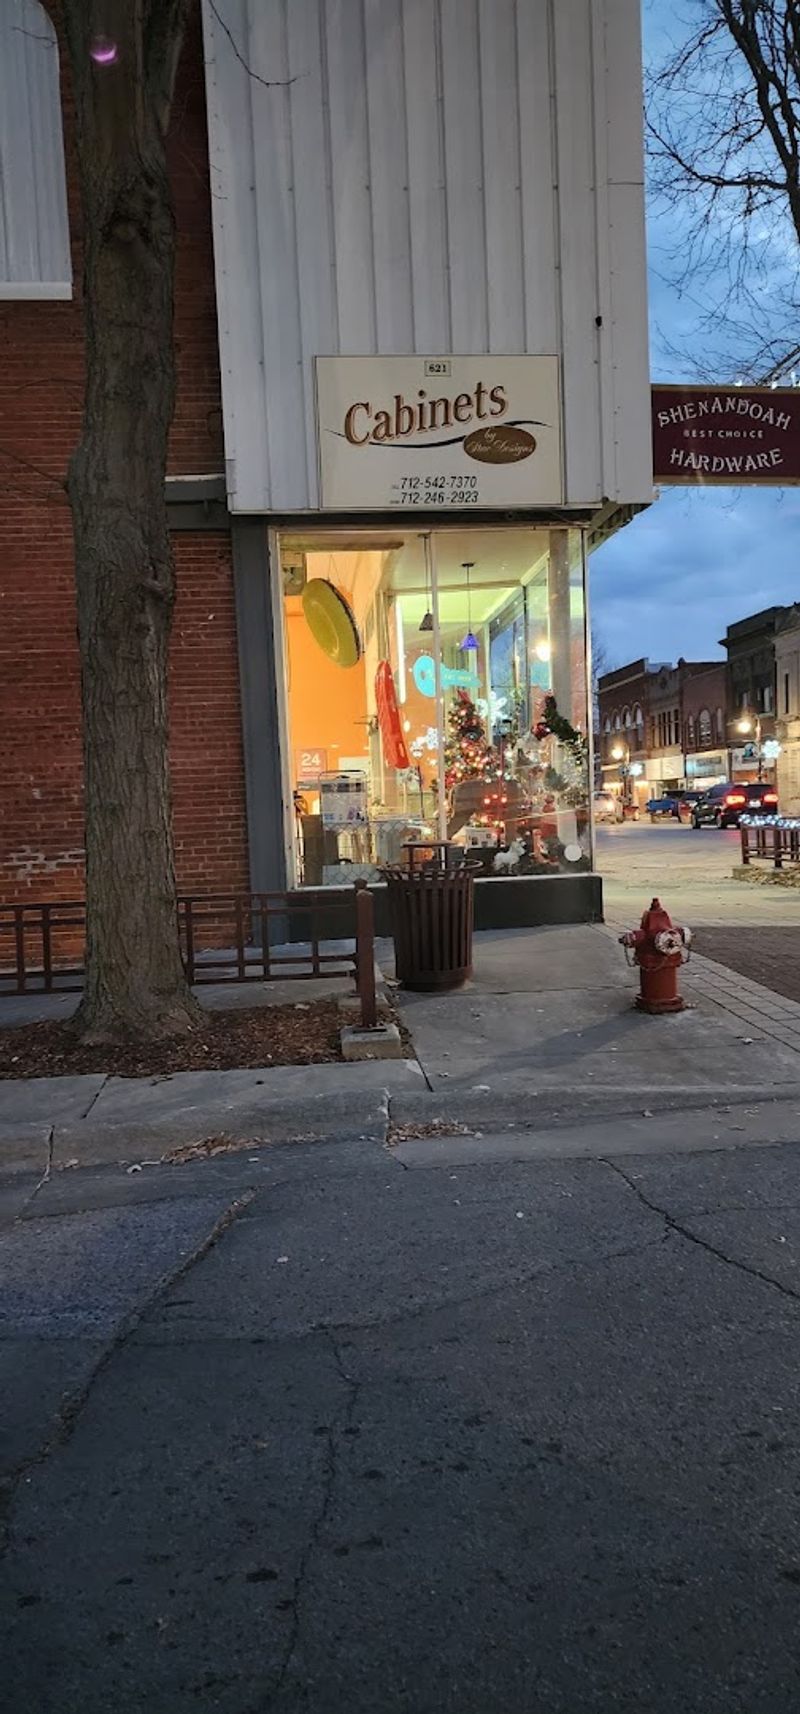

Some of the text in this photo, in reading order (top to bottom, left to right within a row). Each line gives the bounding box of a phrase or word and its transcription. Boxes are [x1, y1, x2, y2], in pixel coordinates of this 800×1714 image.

[429, 363, 446, 373] 621
[344, 381, 508, 447] Cabinets
[657, 396, 792, 430] SHENANDOAH
[484, 428, 497, 443] by
[683, 429, 764, 439] BEST CHOICE
[669, 447, 784, 473] HARDWARE
[401, 475, 478, 489] 712-542-7370
[401, 490, 480, 504] 712-246-2923
[301, 752, 320, 766] 24
